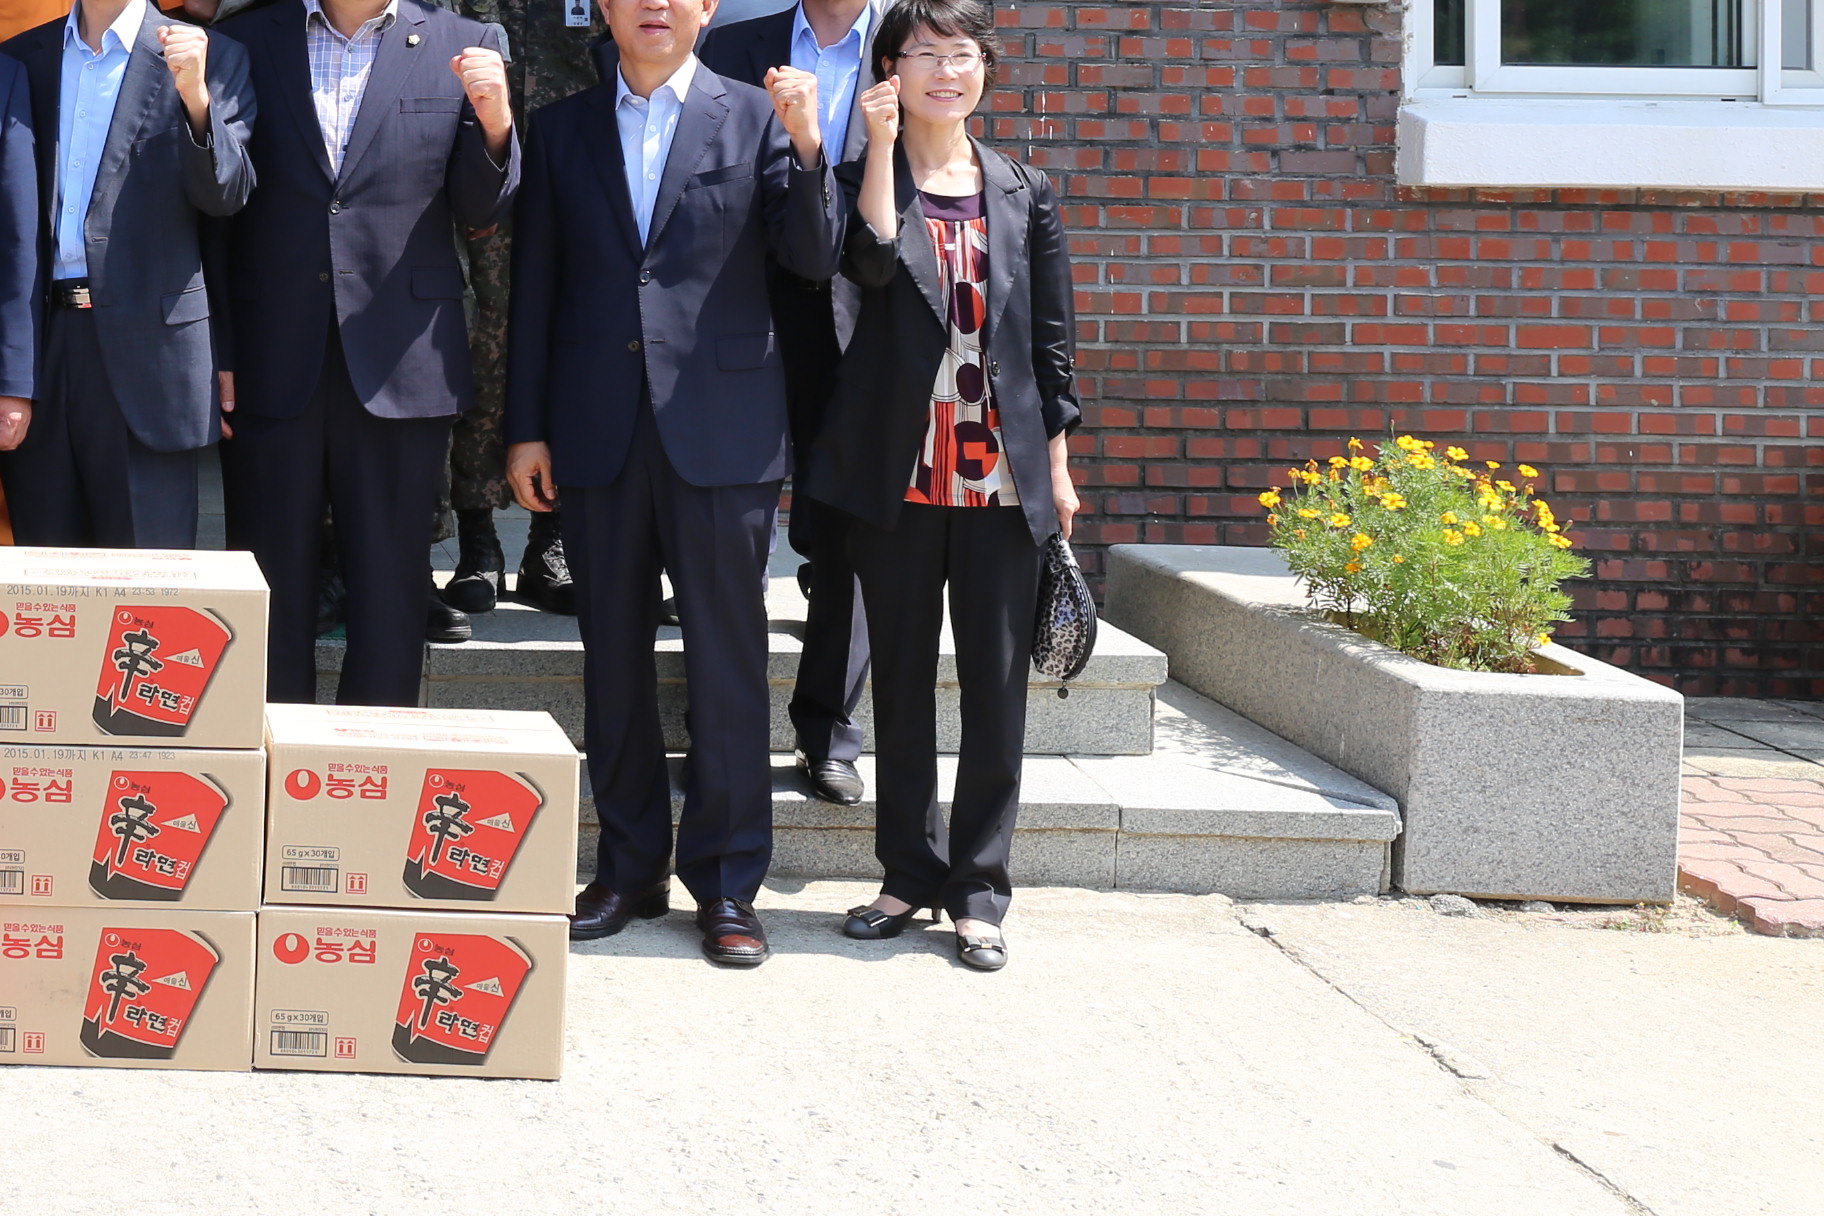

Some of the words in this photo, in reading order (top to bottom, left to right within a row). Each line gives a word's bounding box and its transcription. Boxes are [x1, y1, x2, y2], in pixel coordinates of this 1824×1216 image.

[96, 588, 108, 597] K1
[114, 588, 126, 597] A4
[14, 612, 76, 638] 농심
[112, 628, 164, 701] 辛
[93, 751, 105, 760] K1
[111, 752, 123, 760] A4
[10, 777, 72, 803] 농심
[325, 774, 388, 800] 농심
[109, 793, 160, 867] 辛
[423, 791, 475, 866] 辛
[1, 933, 64, 959] 농심
[314, 937, 376, 964] 농심
[99, 950, 151, 1024] 辛
[412, 955, 464, 1030] 辛
